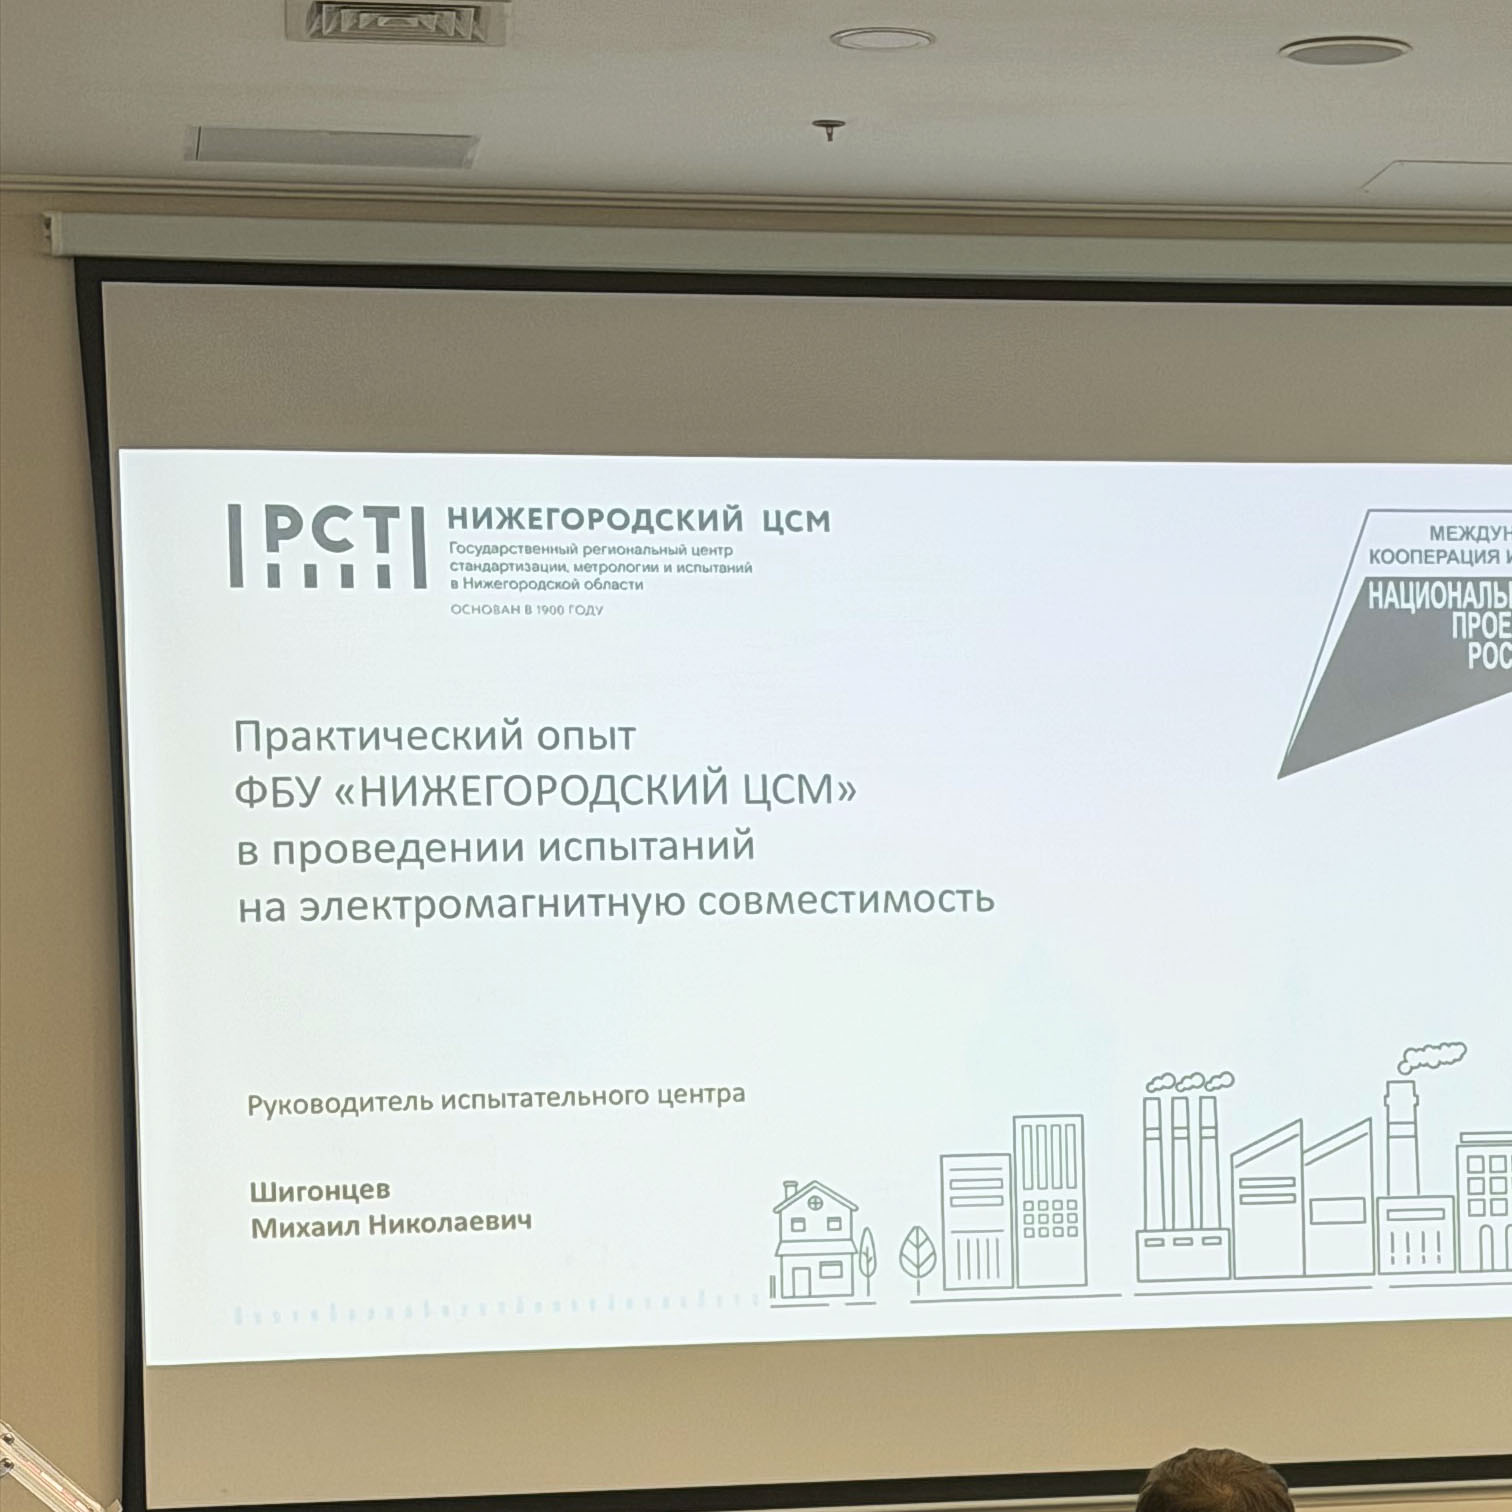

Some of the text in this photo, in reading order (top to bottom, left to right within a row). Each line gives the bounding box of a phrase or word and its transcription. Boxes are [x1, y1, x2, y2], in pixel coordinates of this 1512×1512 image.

[447, 503, 831, 536] НИЖЕГОРОДСКИЙ ЦСМ
[449, 541, 734, 559] Государственный региональный центр
[1369, 548, 1500, 567] КООПЕРАЦИЯ
[449, 561, 753, 576] стандартизации, метрологии и испытаний
[450, 576, 644, 593] в Нижегородской области
[450, 603, 604, 617] ОСНОВАН В 1900 ГОДУ
[235, 717, 637, 756] Практический опыт
[235, 765, 857, 813] ФБУ «НИЖЕГОРОДСКИЙ ЦСМ»
[238, 827, 754, 873] в проведении испытаний
[239, 889, 995, 928] на электромагнитную совместимость
[248, 1086, 746, 1121] Руководитель испытательного центра
[250, 1181, 391, 1205] Шигонцев
[251, 1213, 532, 1239] Михаил Николаевич
